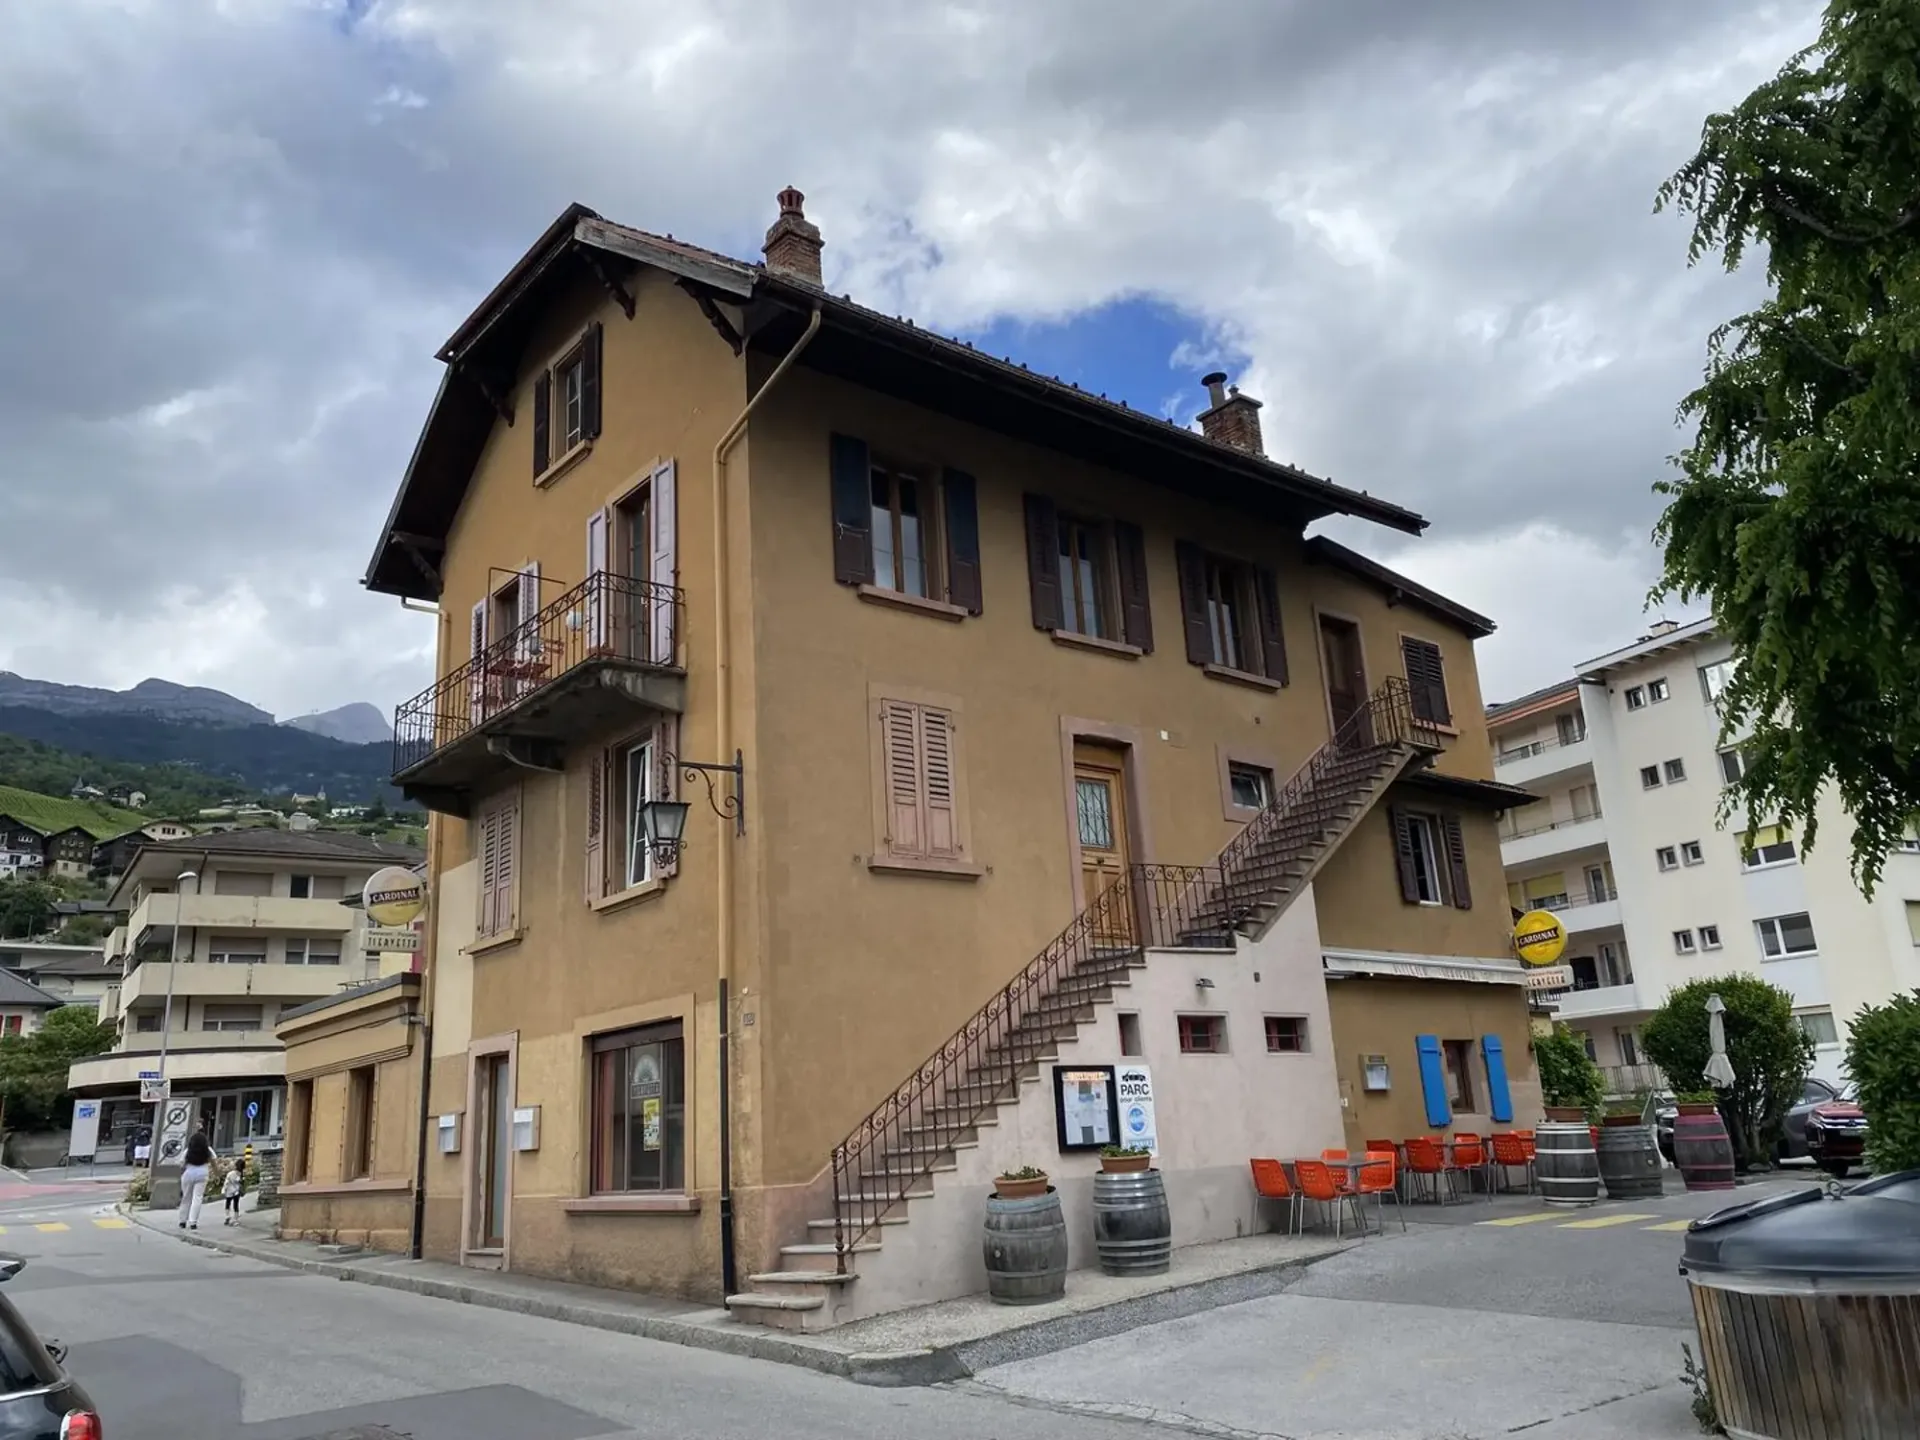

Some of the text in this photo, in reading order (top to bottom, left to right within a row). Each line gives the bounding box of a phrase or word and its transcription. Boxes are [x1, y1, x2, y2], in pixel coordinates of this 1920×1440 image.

[372, 889, 417, 903] CARDINAL
[1519, 929, 1557, 945] CARDINAL
[1120, 1083, 1150, 1096] PARC
